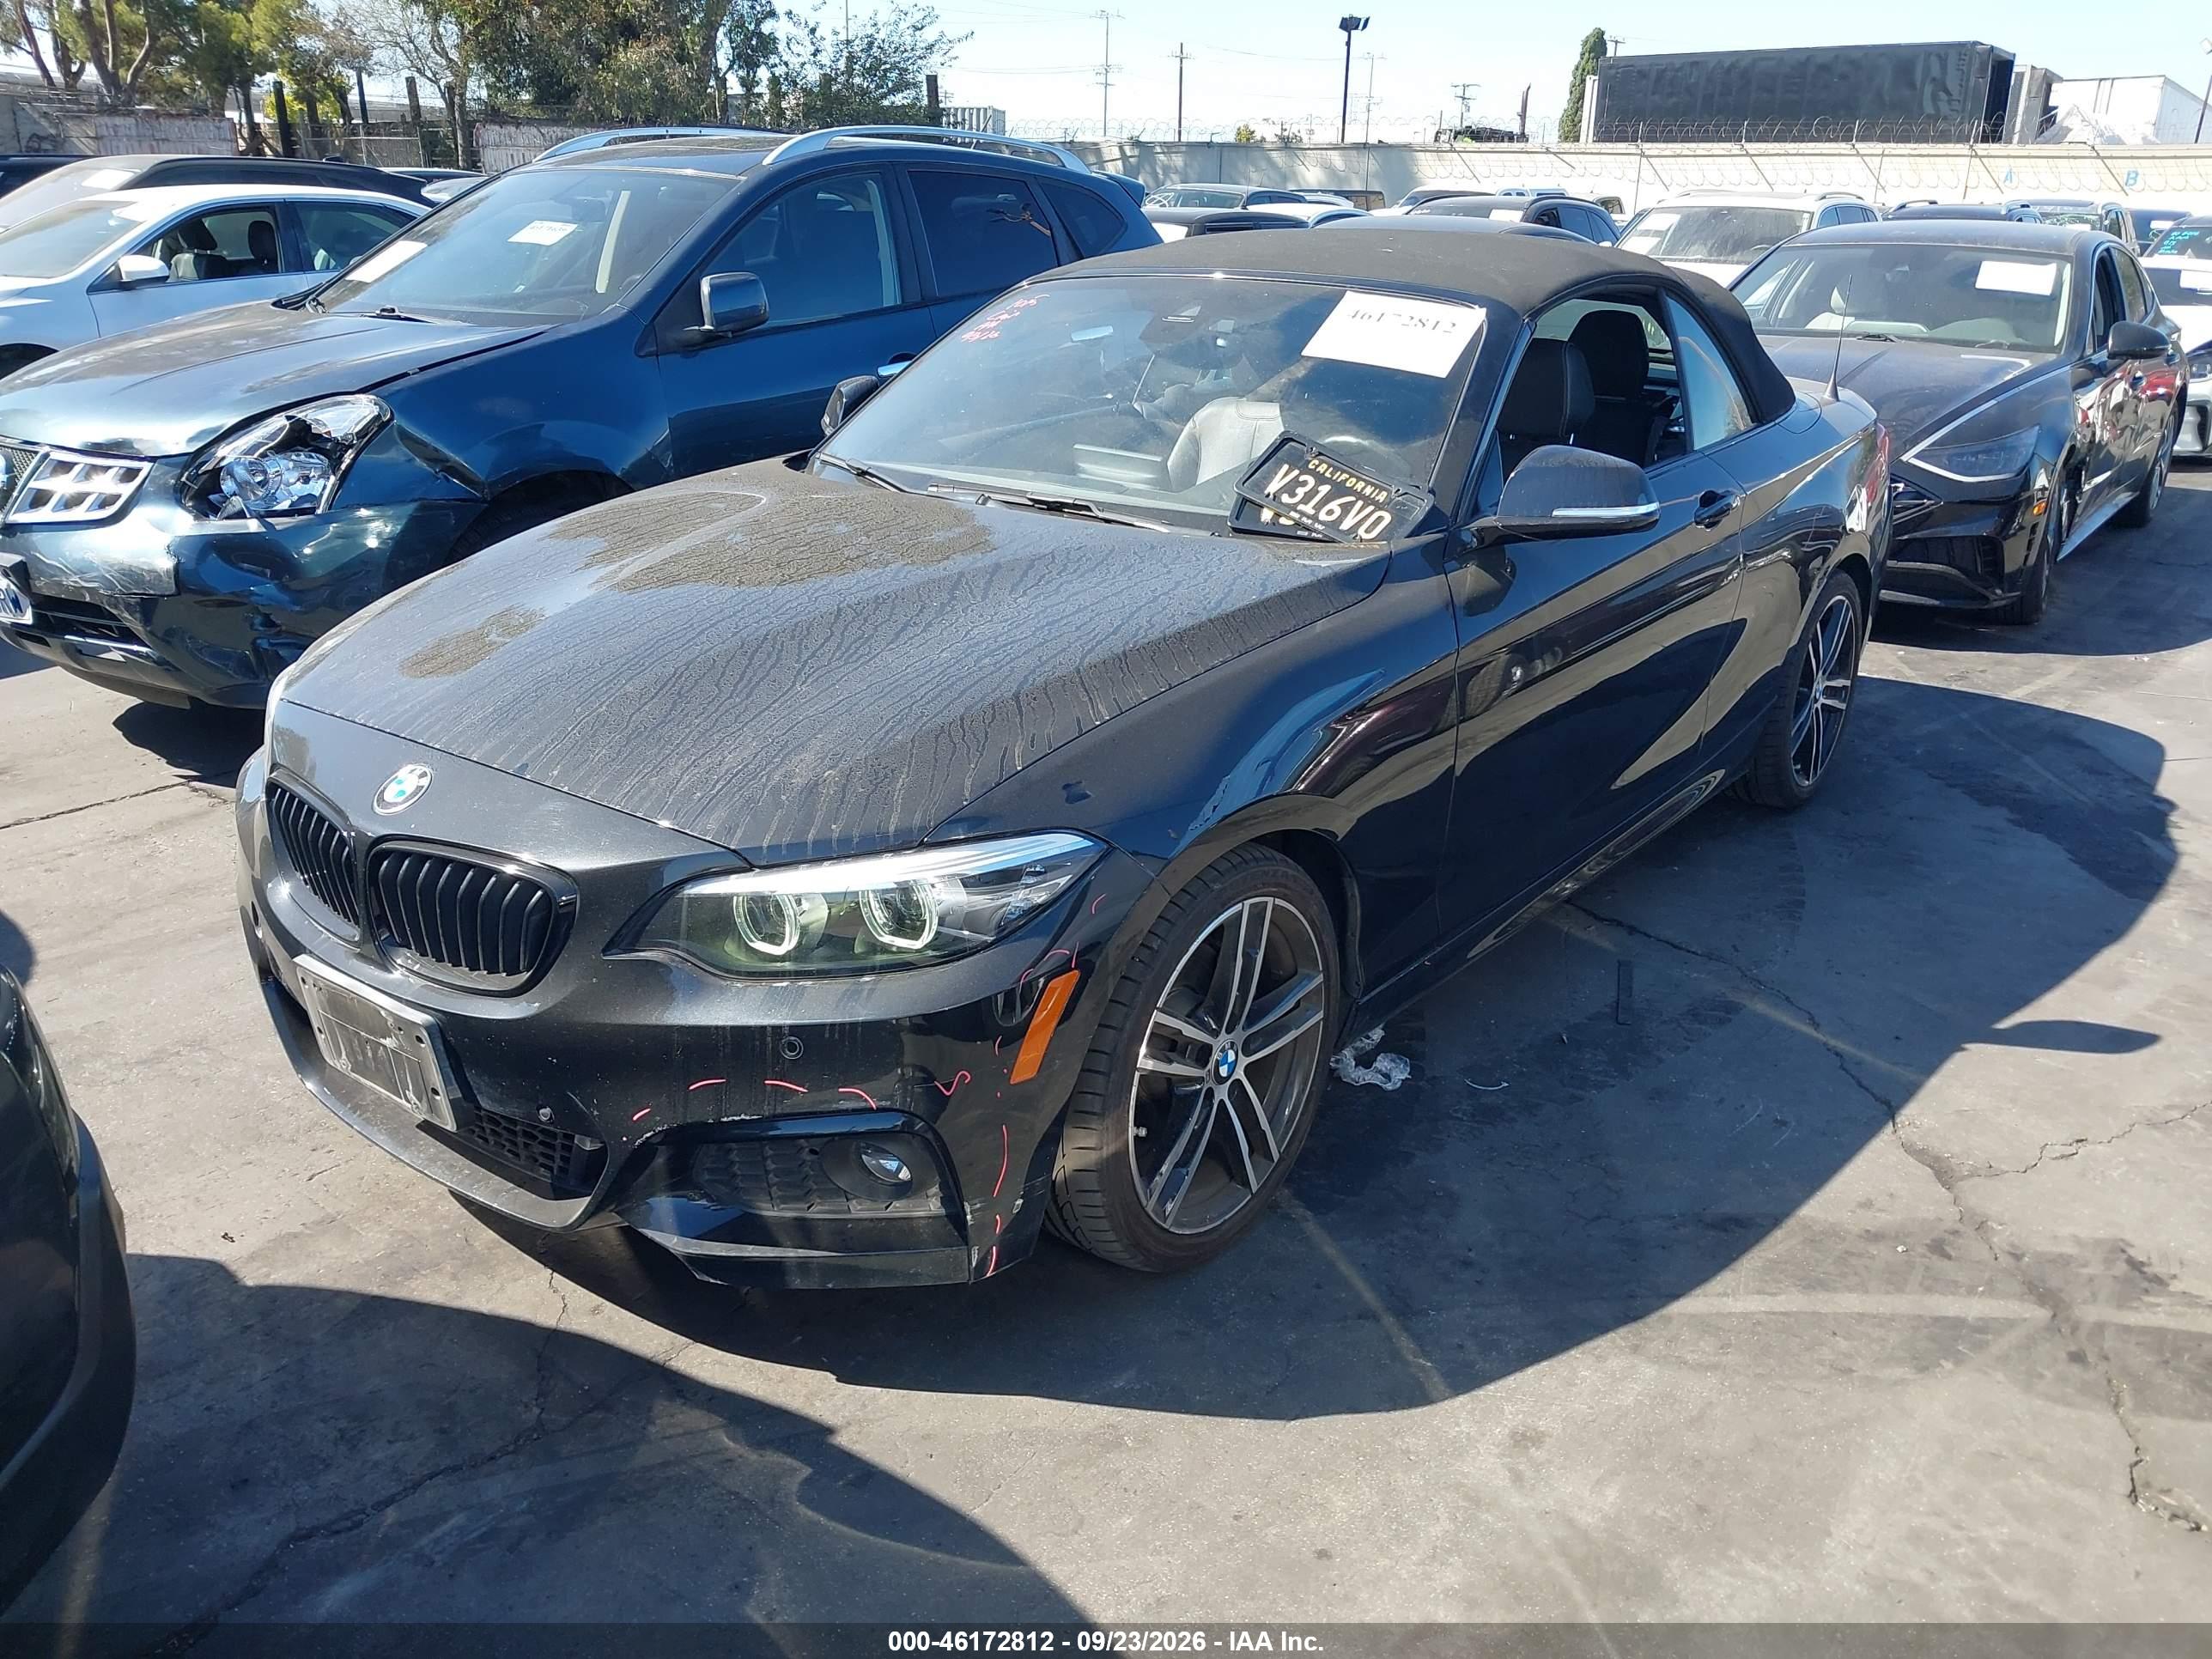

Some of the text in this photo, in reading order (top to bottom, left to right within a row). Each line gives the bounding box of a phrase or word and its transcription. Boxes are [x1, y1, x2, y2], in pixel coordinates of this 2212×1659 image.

[2003, 165, 2014, 185] A
[2124, 170, 2140, 187] B
[1308, 459, 1389, 503] CALIFORNIA
